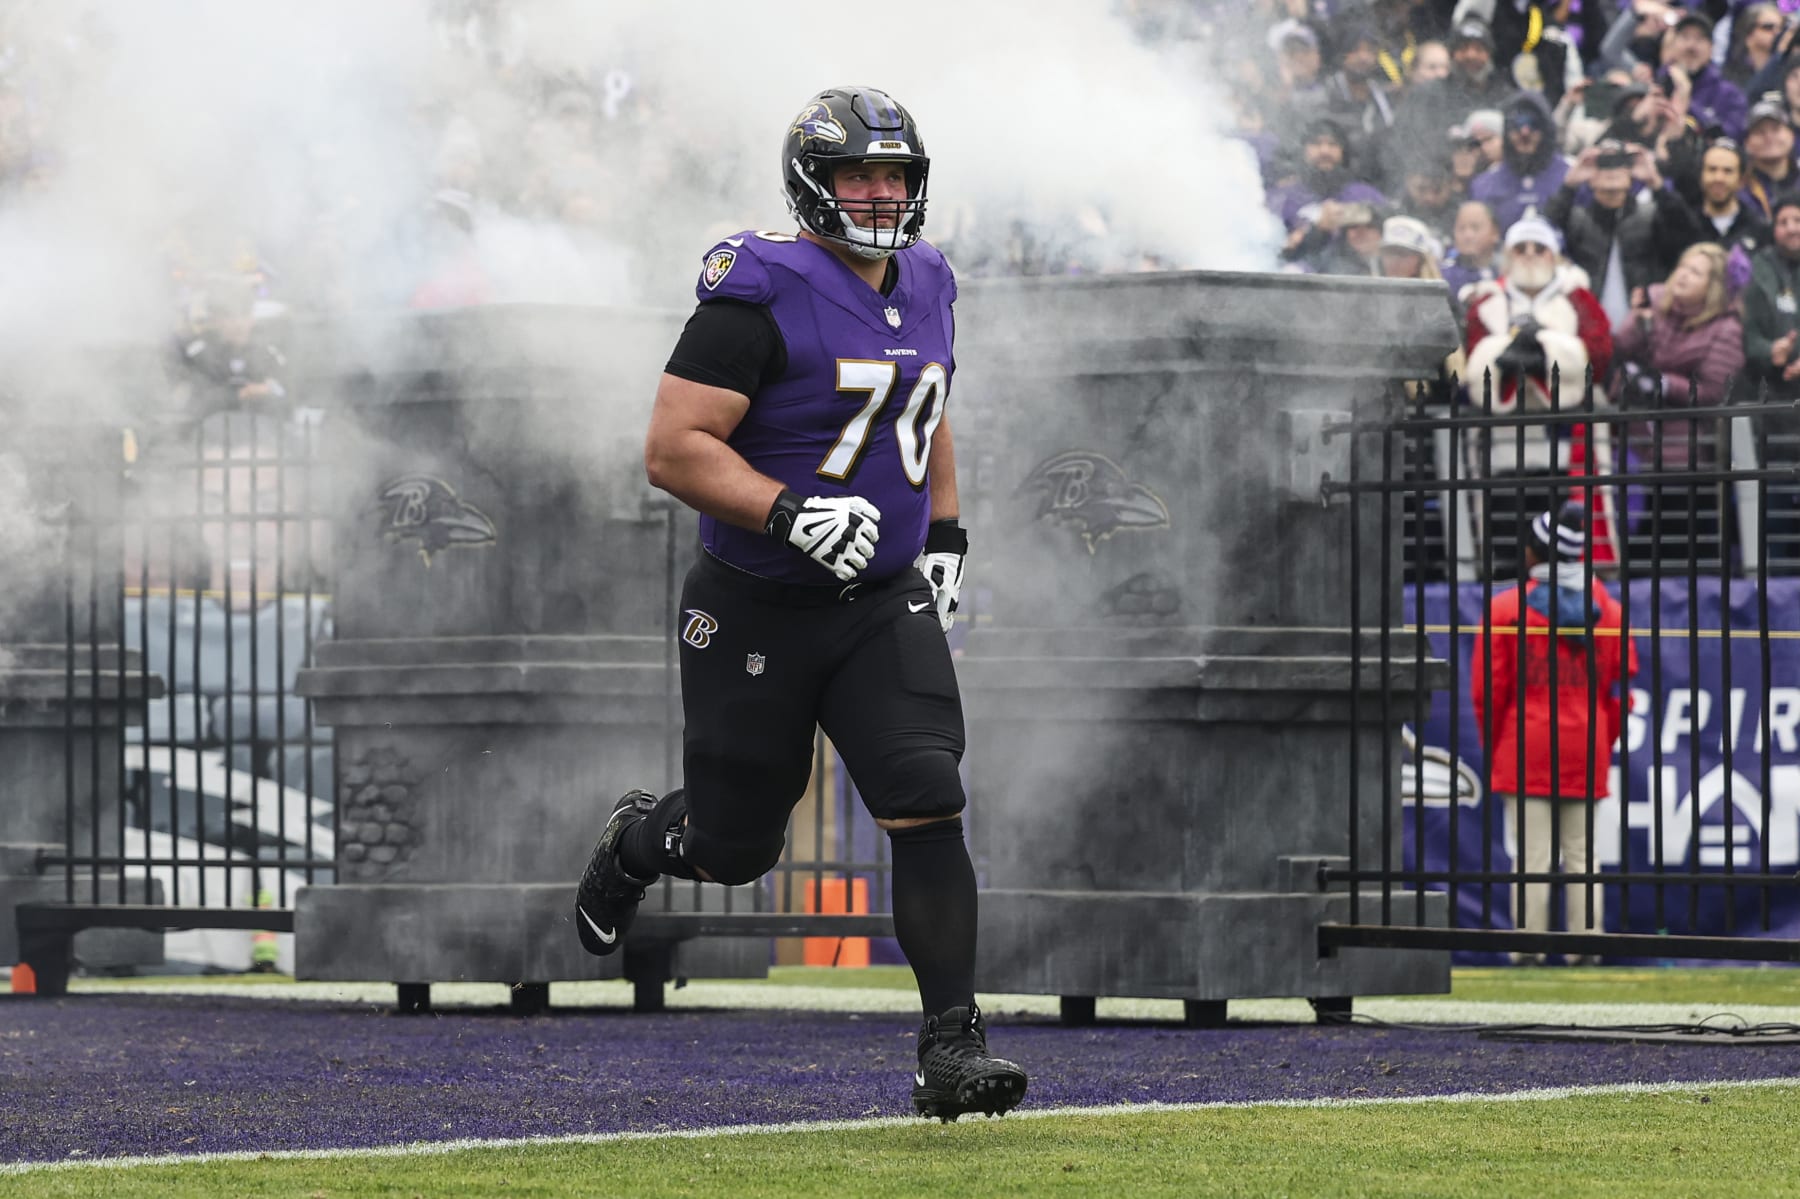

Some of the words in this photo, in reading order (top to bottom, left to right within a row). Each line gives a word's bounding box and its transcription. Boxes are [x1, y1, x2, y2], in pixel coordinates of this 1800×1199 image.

[883, 348, 918, 356] RAVENS
[816, 358, 947, 486] 70
[683, 609, 719, 649] B
